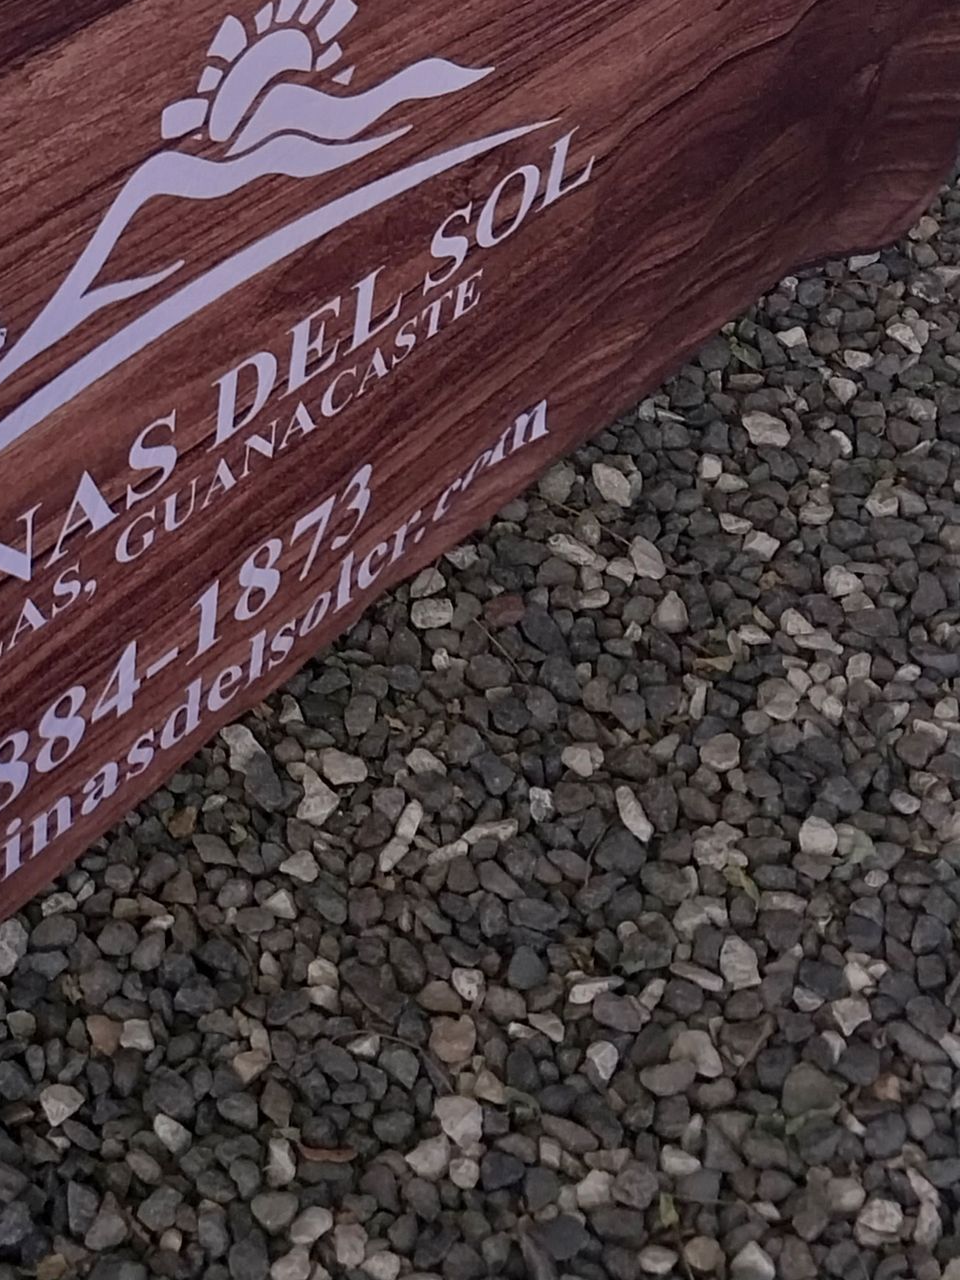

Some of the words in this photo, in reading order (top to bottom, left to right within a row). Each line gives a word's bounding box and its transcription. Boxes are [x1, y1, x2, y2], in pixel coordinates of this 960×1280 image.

[114, 267, 483, 566] GUANACASTE
[212, 263, 404, 457] DEL
[422, 125, 597, 297] SOL
